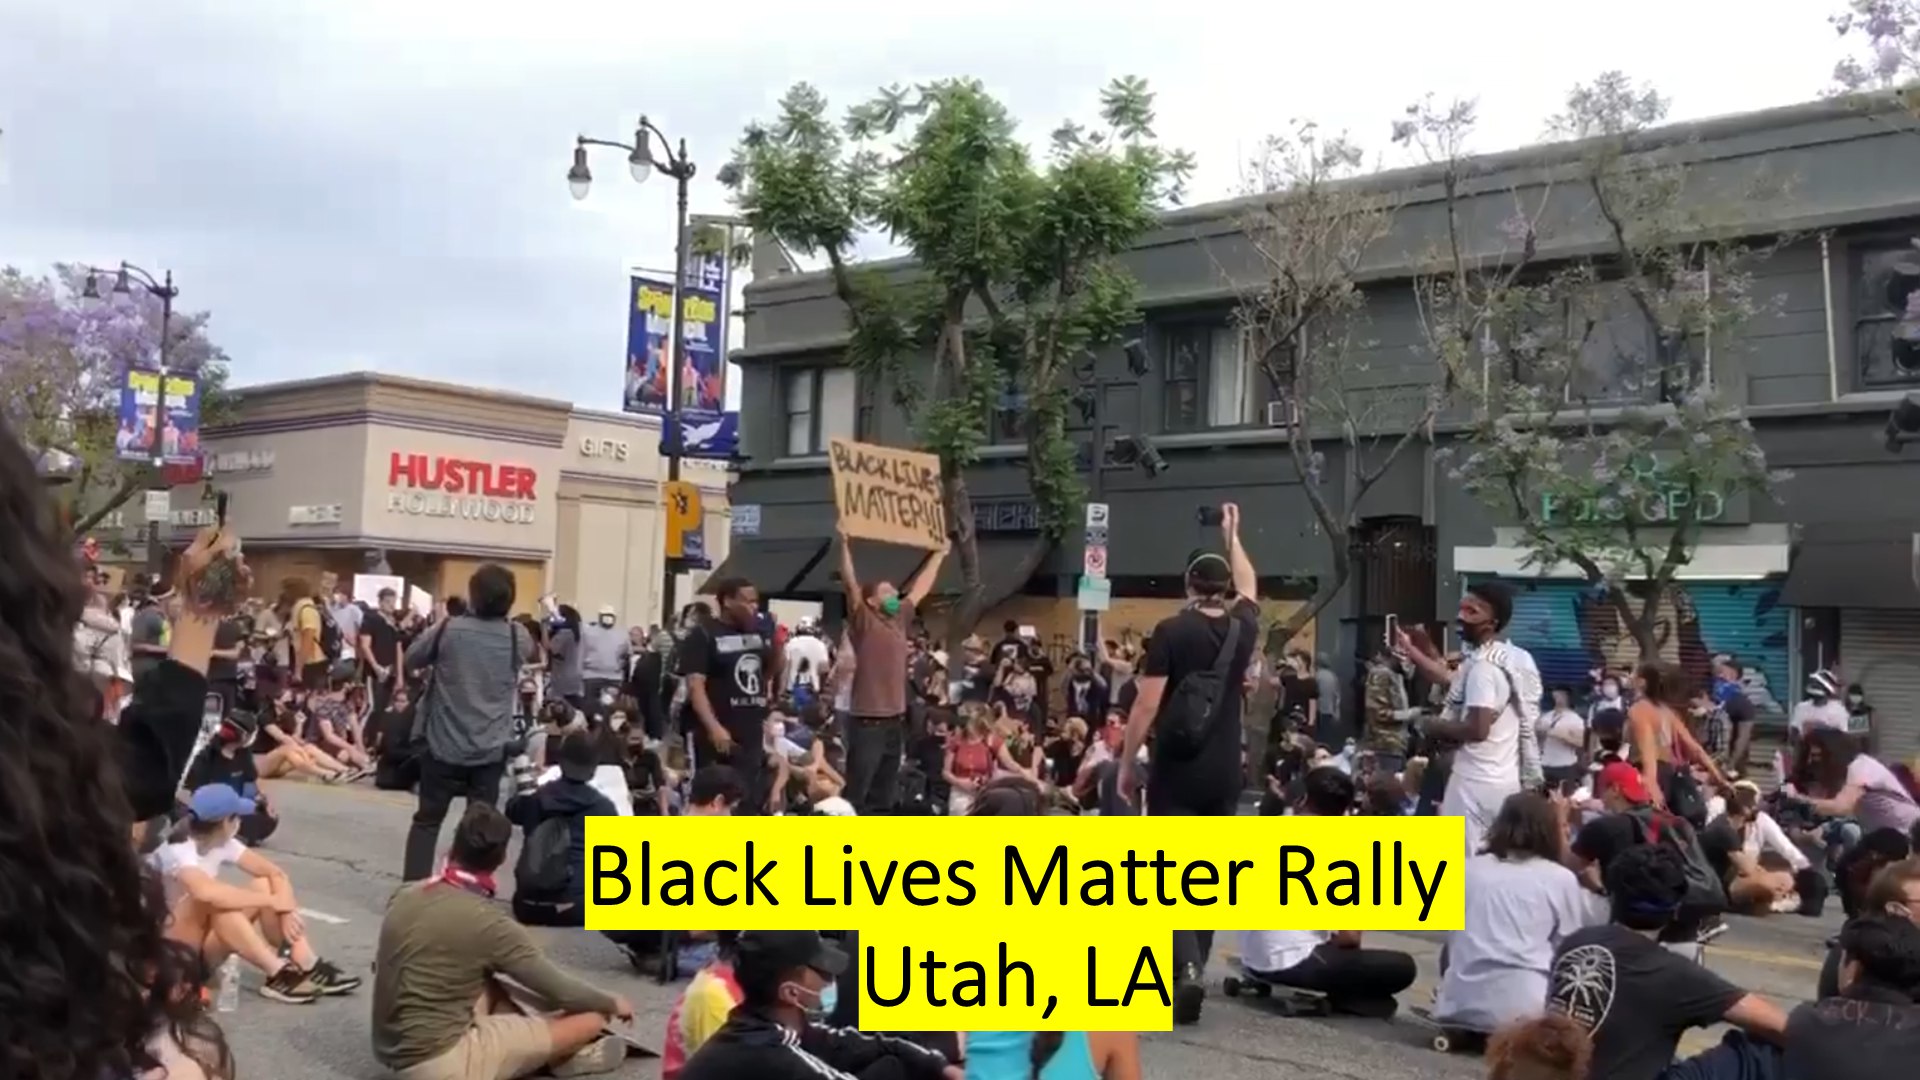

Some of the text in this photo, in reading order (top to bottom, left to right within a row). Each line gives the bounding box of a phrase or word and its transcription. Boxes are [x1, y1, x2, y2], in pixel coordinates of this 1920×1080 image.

[580, 437, 629, 462] GIFTS
[831, 440, 892, 479] BLACK
[388, 452, 537, 500] HUSTLER
[387, 491, 536, 525] HOLLYWOOD
[844, 481, 945, 544] MATTER!!!
